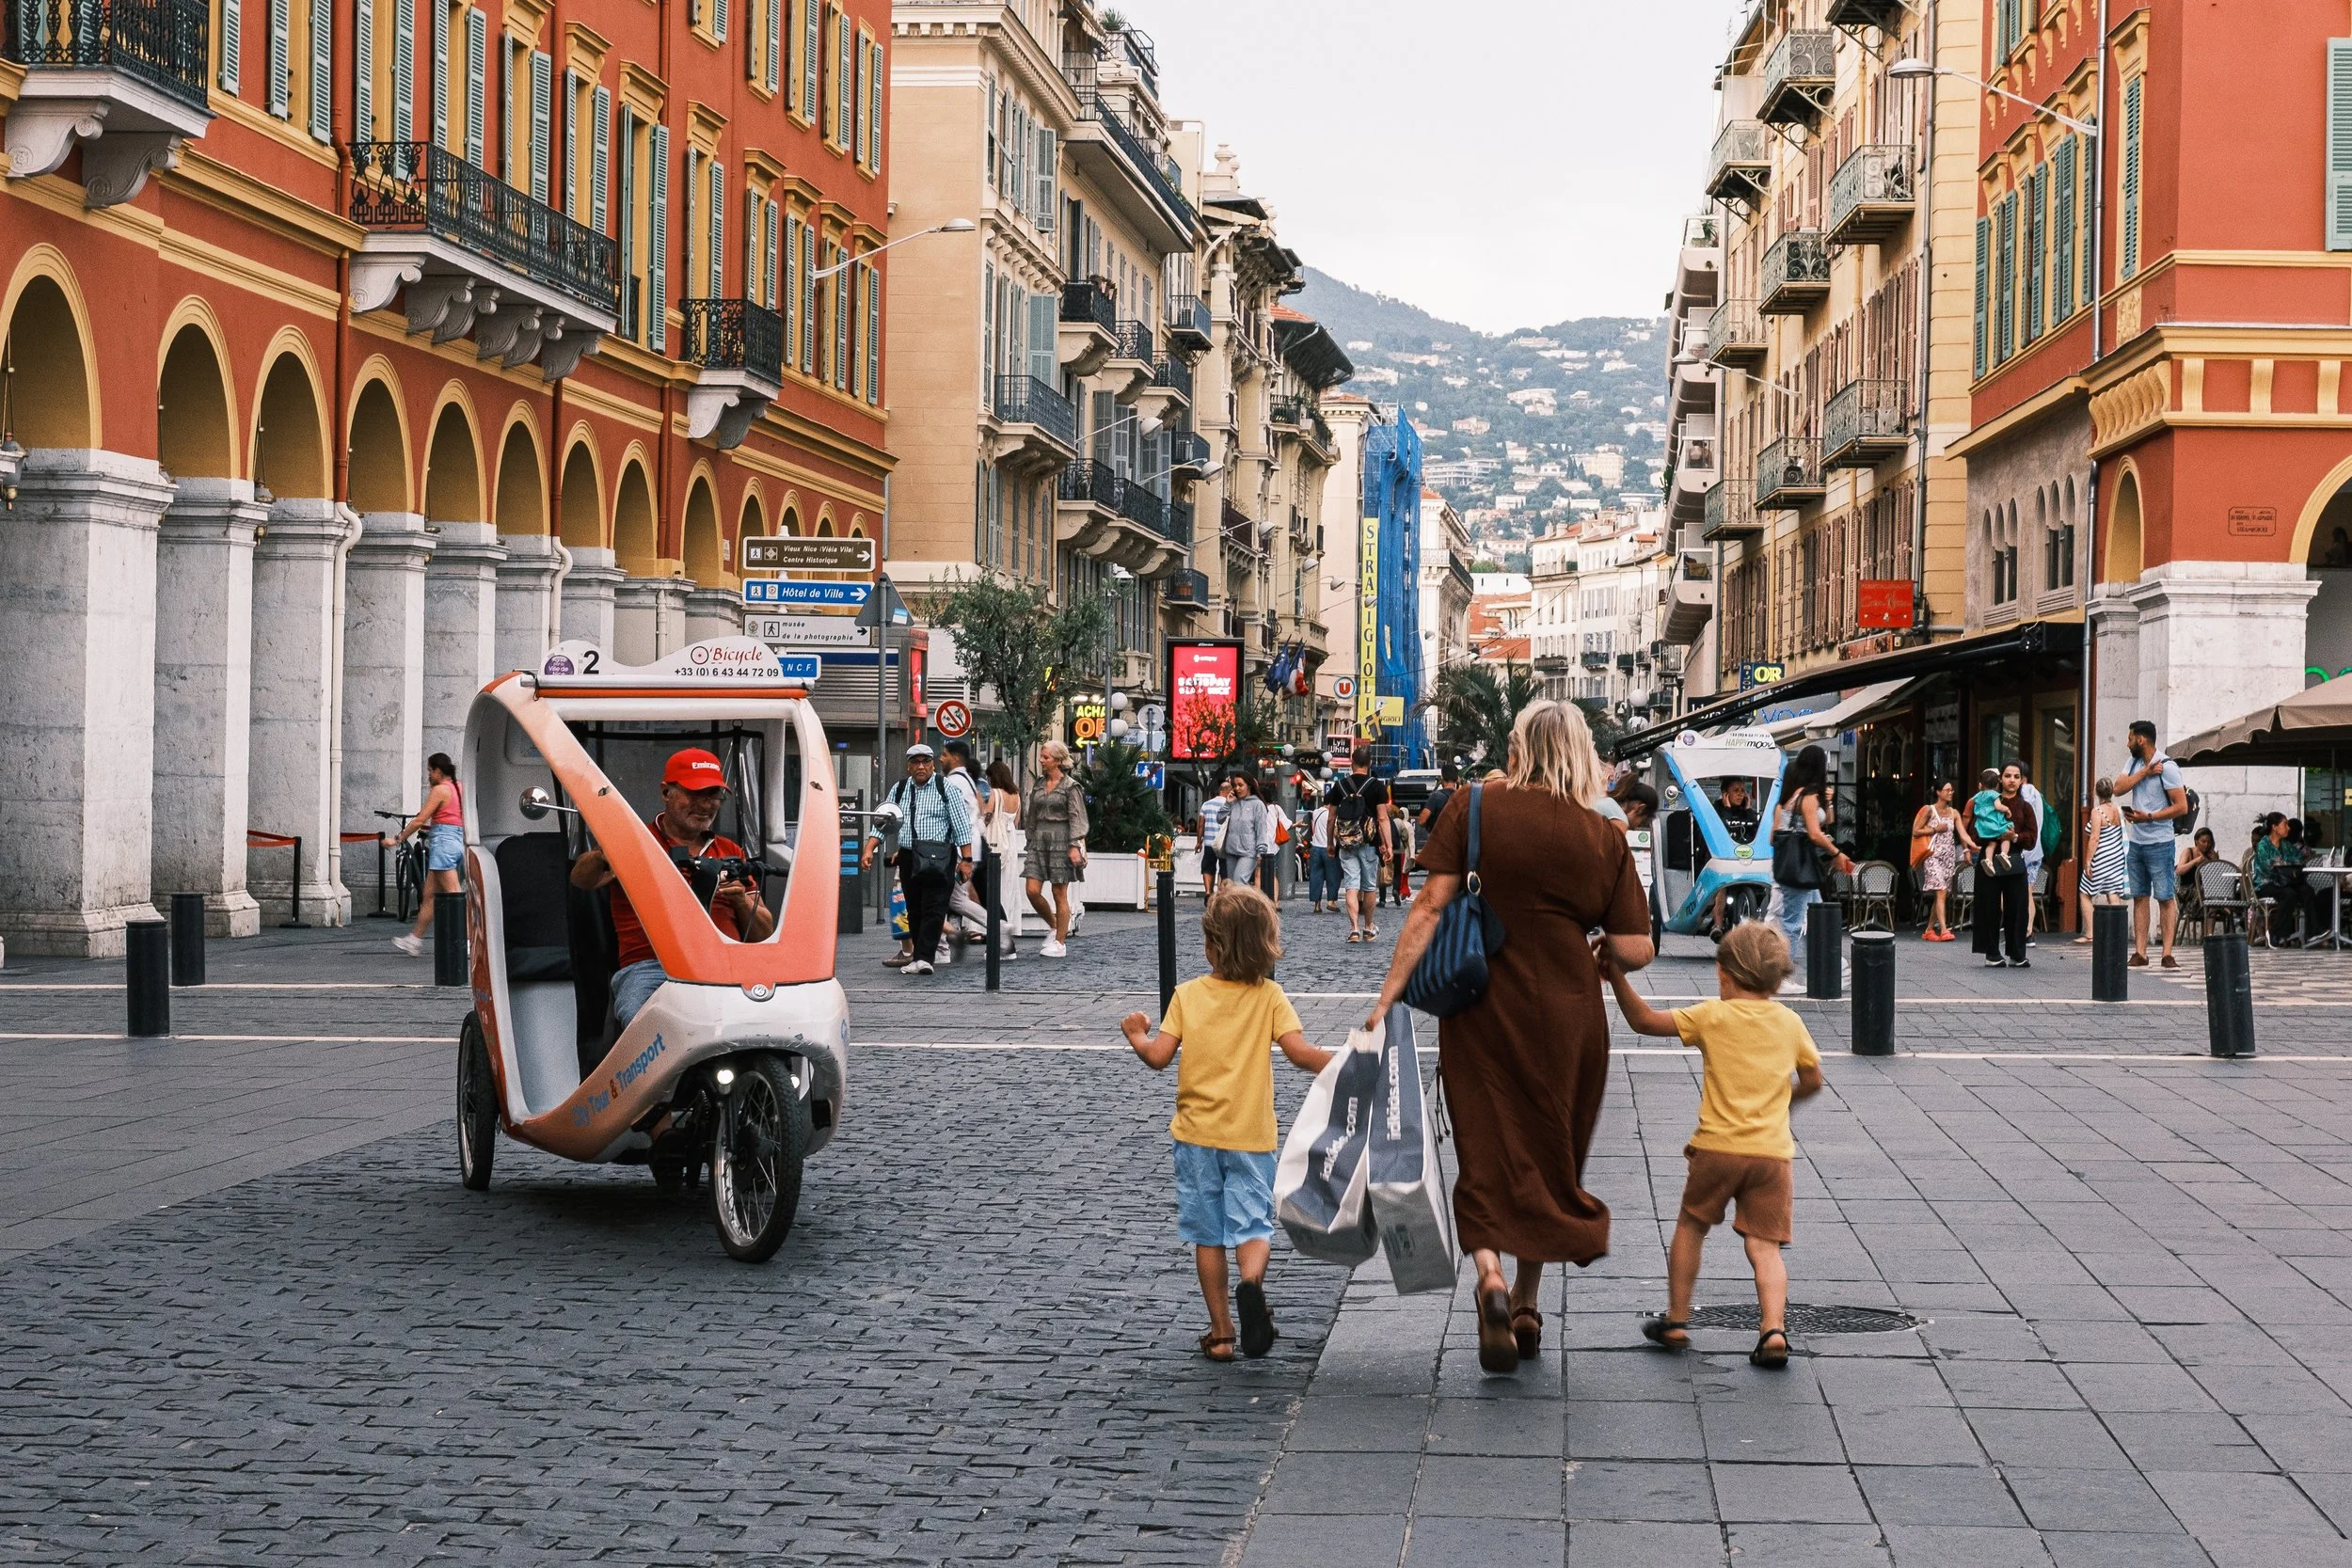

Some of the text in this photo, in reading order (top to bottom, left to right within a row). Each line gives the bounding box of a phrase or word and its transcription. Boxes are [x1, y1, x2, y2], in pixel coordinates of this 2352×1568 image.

[782, 587, 844, 598] Hôtel de Ville
[1363, 525, 1375, 711] STRAIGIOLI
[804, 633, 853, 641] photographie
[583, 650, 599, 674] 2
[675, 668, 779, 677] +33 (0) 6 43 44 72 09
[1754, 666, 1783, 683] OR
[1339, 682, 1351, 694] U
[1327, 745, 1350, 753] White
[616, 1032, 666, 1091] Transport
